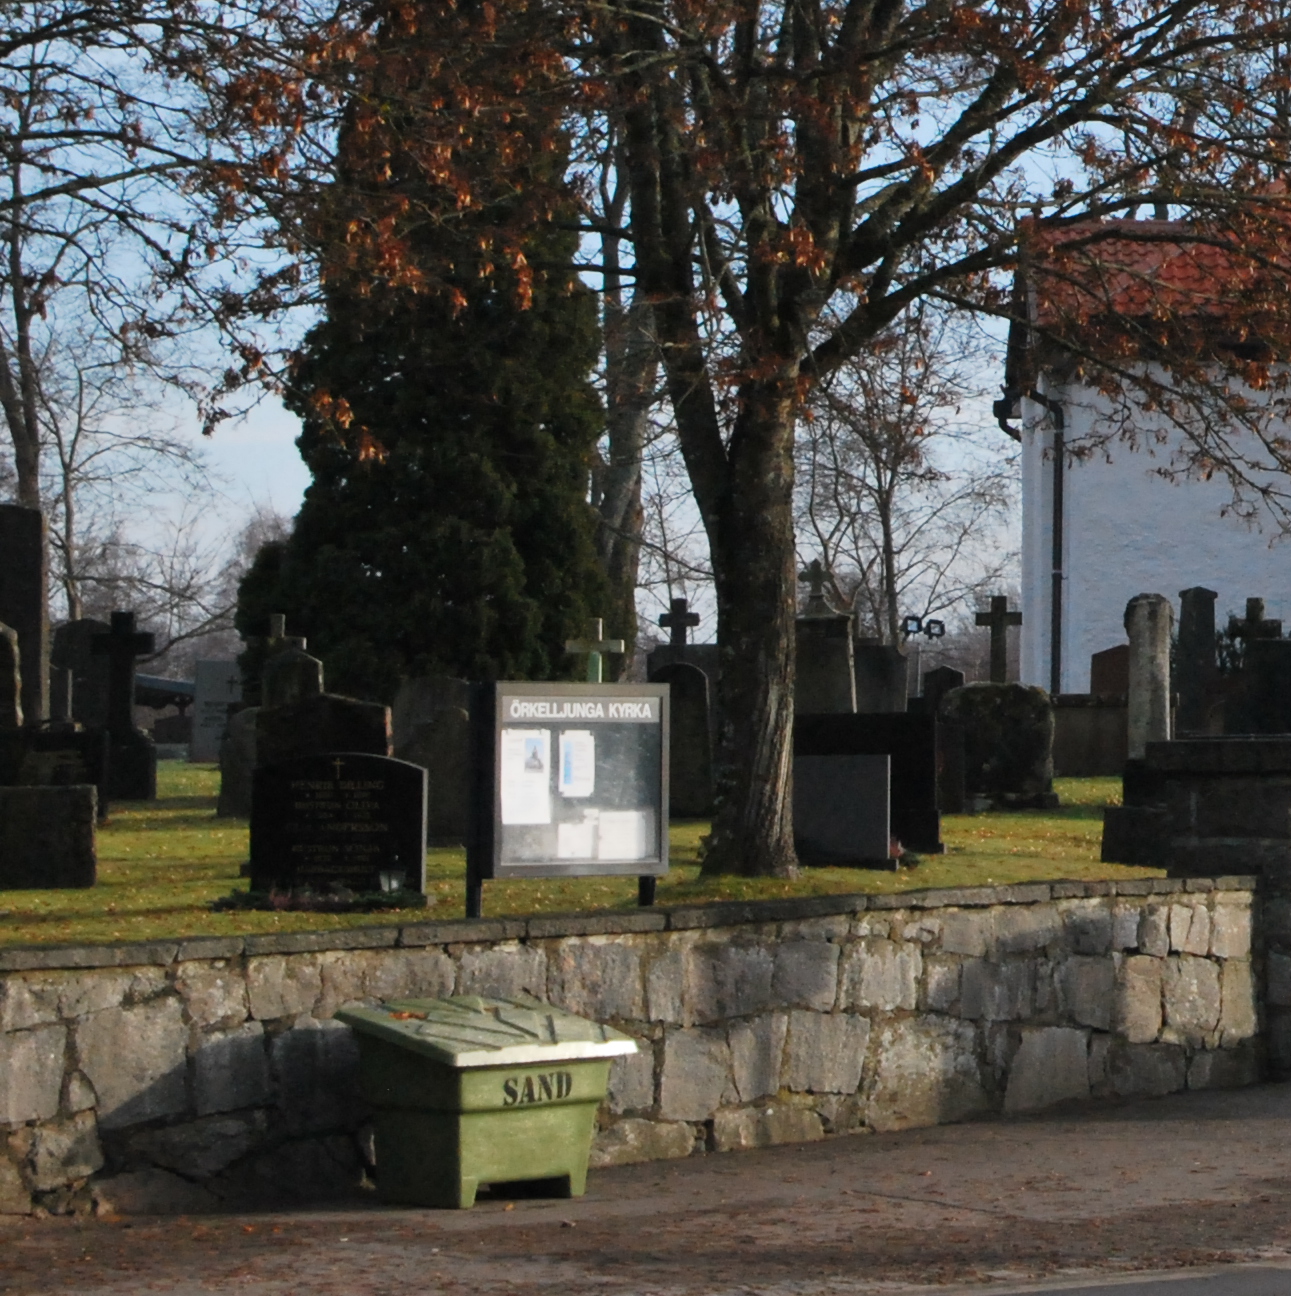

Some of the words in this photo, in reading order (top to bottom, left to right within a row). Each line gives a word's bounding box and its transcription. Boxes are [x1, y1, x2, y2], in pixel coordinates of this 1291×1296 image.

[510, 699, 604, 718] ÖRKELLJUNGA
[608, 703, 652, 718] KYRKA
[503, 1071, 572, 1106] SAND
